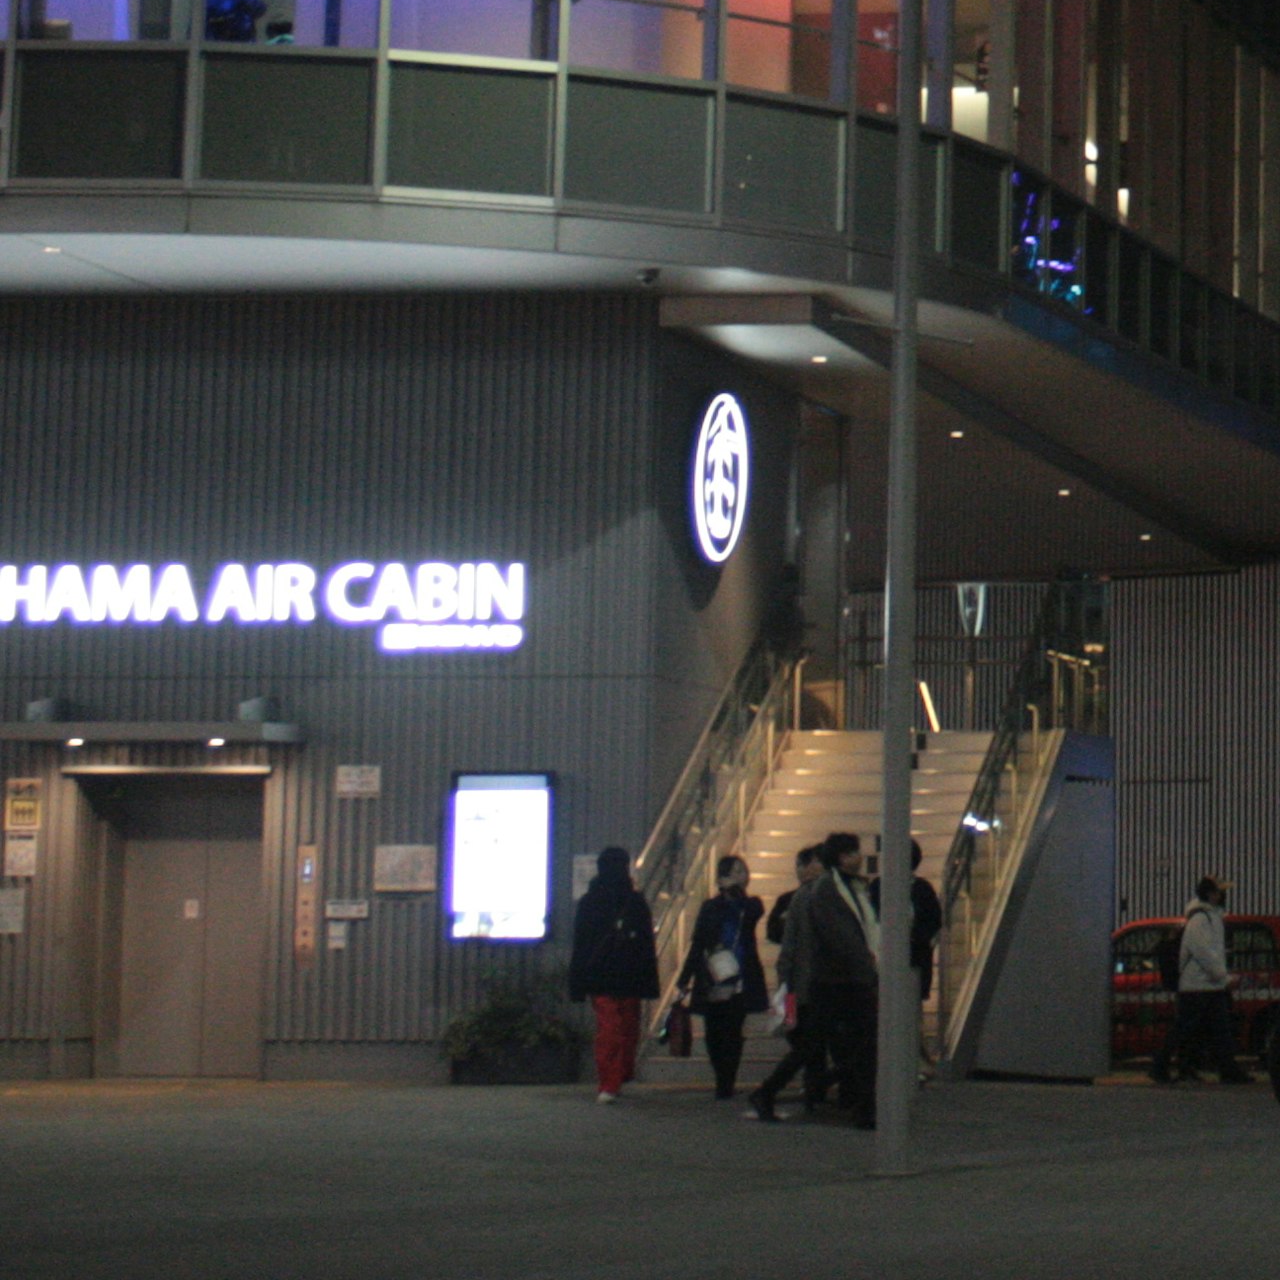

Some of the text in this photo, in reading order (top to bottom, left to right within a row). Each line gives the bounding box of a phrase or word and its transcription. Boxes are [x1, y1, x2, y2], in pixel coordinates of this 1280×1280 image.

[0, 562, 525, 622] HAMA AIR CABIN
